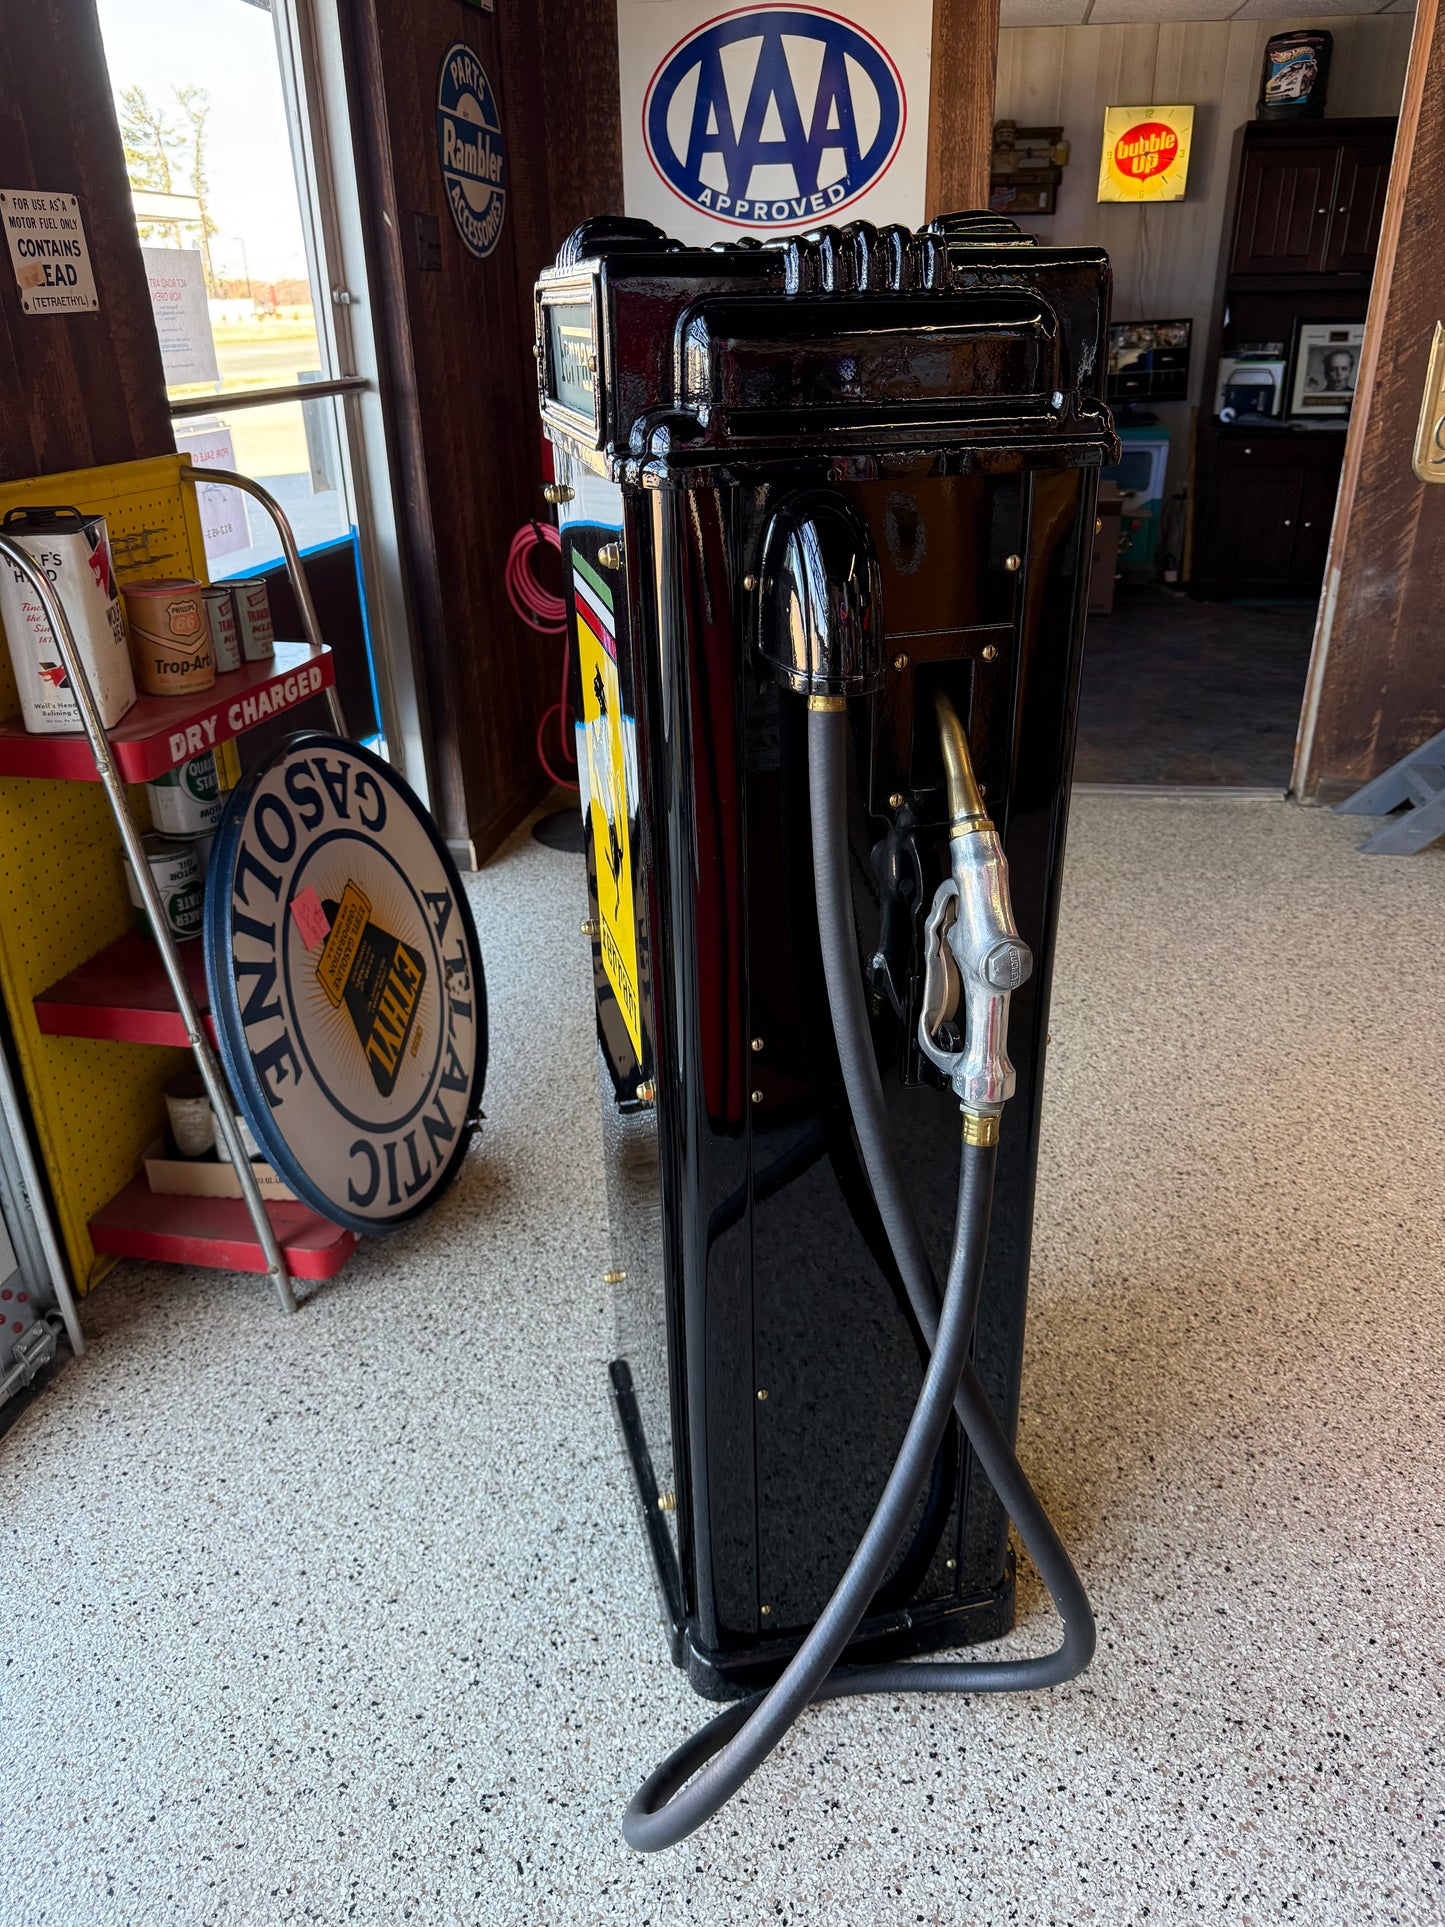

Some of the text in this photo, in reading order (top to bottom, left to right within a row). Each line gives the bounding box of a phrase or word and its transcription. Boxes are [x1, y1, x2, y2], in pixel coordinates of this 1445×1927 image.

[450, 55, 485, 101] PARTS
[684, 33, 862, 201] AAA
[443, 118, 503, 183] Rambler
[1117, 131, 1176, 160] bubble
[12, 198, 67, 212] FOR USE AS A
[451, 185, 501, 247] ACCESSORIES
[696, 184, 847, 221] APPROVED
[9, 216, 78, 230] MOTOR FUEL ONLY
[17, 238, 82, 257] CONTAINS
[37, 264, 78, 287] EAD
[32, 295, 89, 310] (TETRAETHYL)
[4, 551, 62, 568] WF'S
[14, 569, 58, 583] HD
[171, 604, 195, 614] PHILLIPS
[176, 615, 196, 631] 66
[169, 666, 323, 763] DRY CHARGED
[178, 859, 193, 868] OIL
[231, 757, 387, 1109] GASOLINE
[328, 903, 356, 976] CORPORATION
[333, 939, 356, 990] GASOLINE
[600, 910, 638, 1033] Ferrari
[366, 941, 422, 1078] ETHYL
[347, 886, 476, 1208] ATLANTIC
